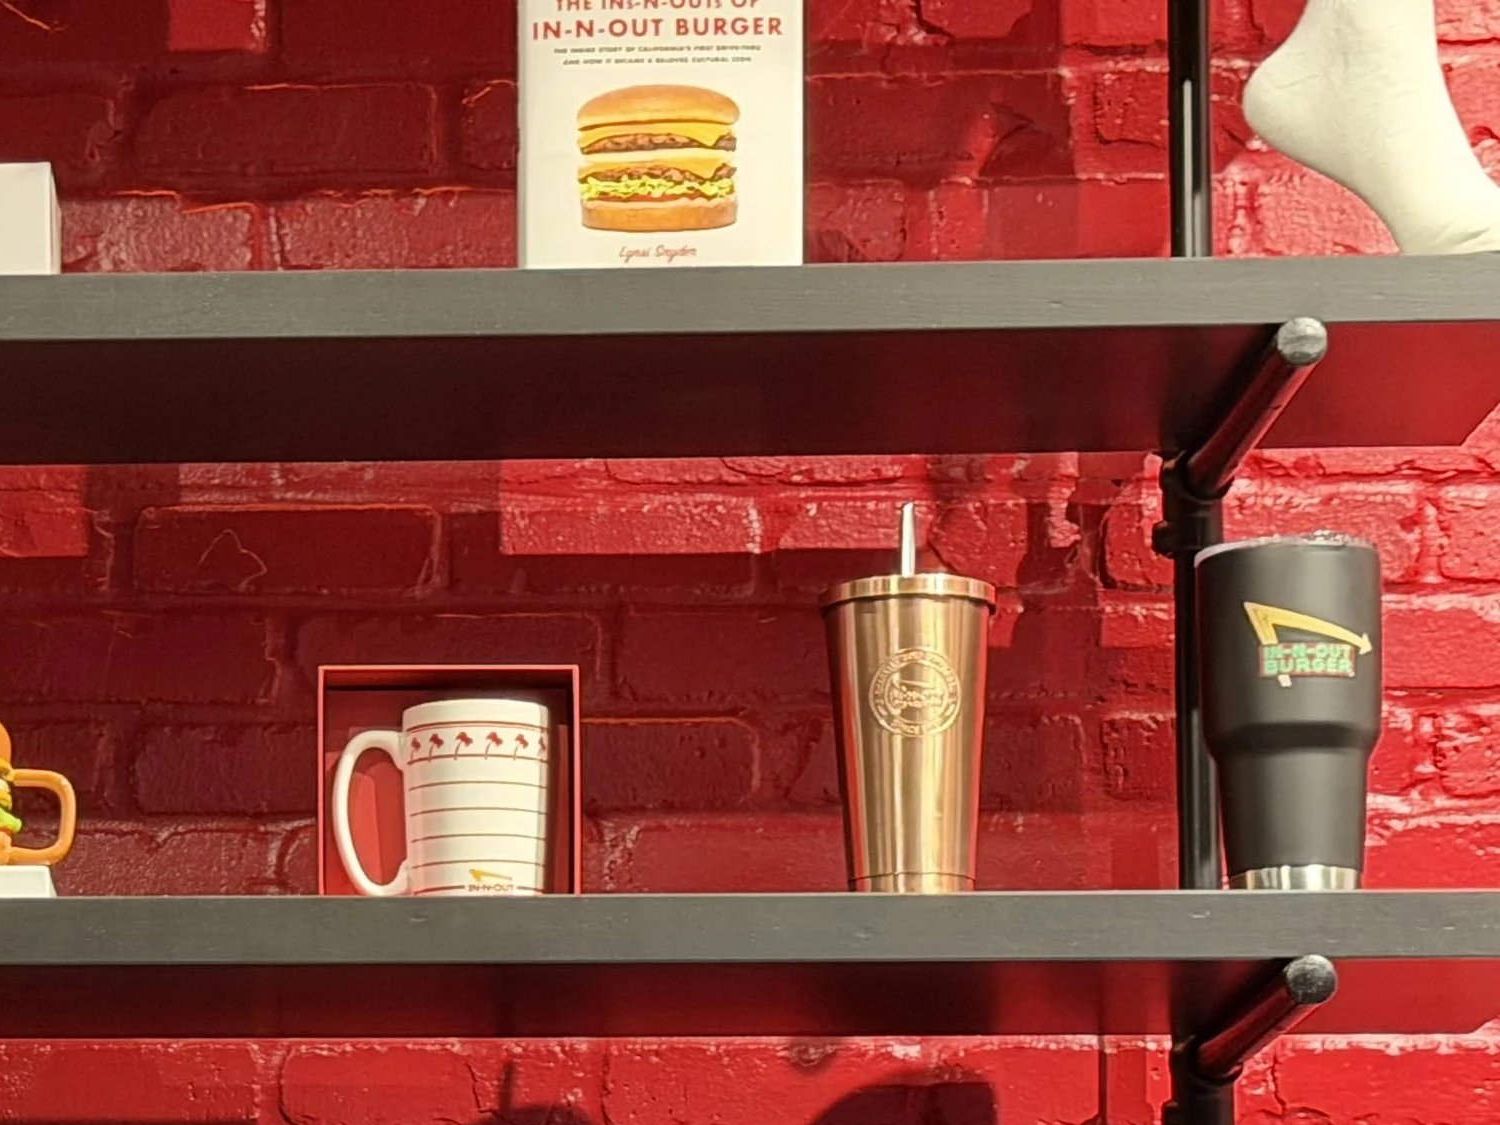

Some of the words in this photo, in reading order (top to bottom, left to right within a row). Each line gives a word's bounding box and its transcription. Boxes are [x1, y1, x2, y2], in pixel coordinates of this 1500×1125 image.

[556, 0, 592, 11] THE
[533, 18, 664, 40] IN-N-OUT
[675, 16, 783, 37] BURGER
